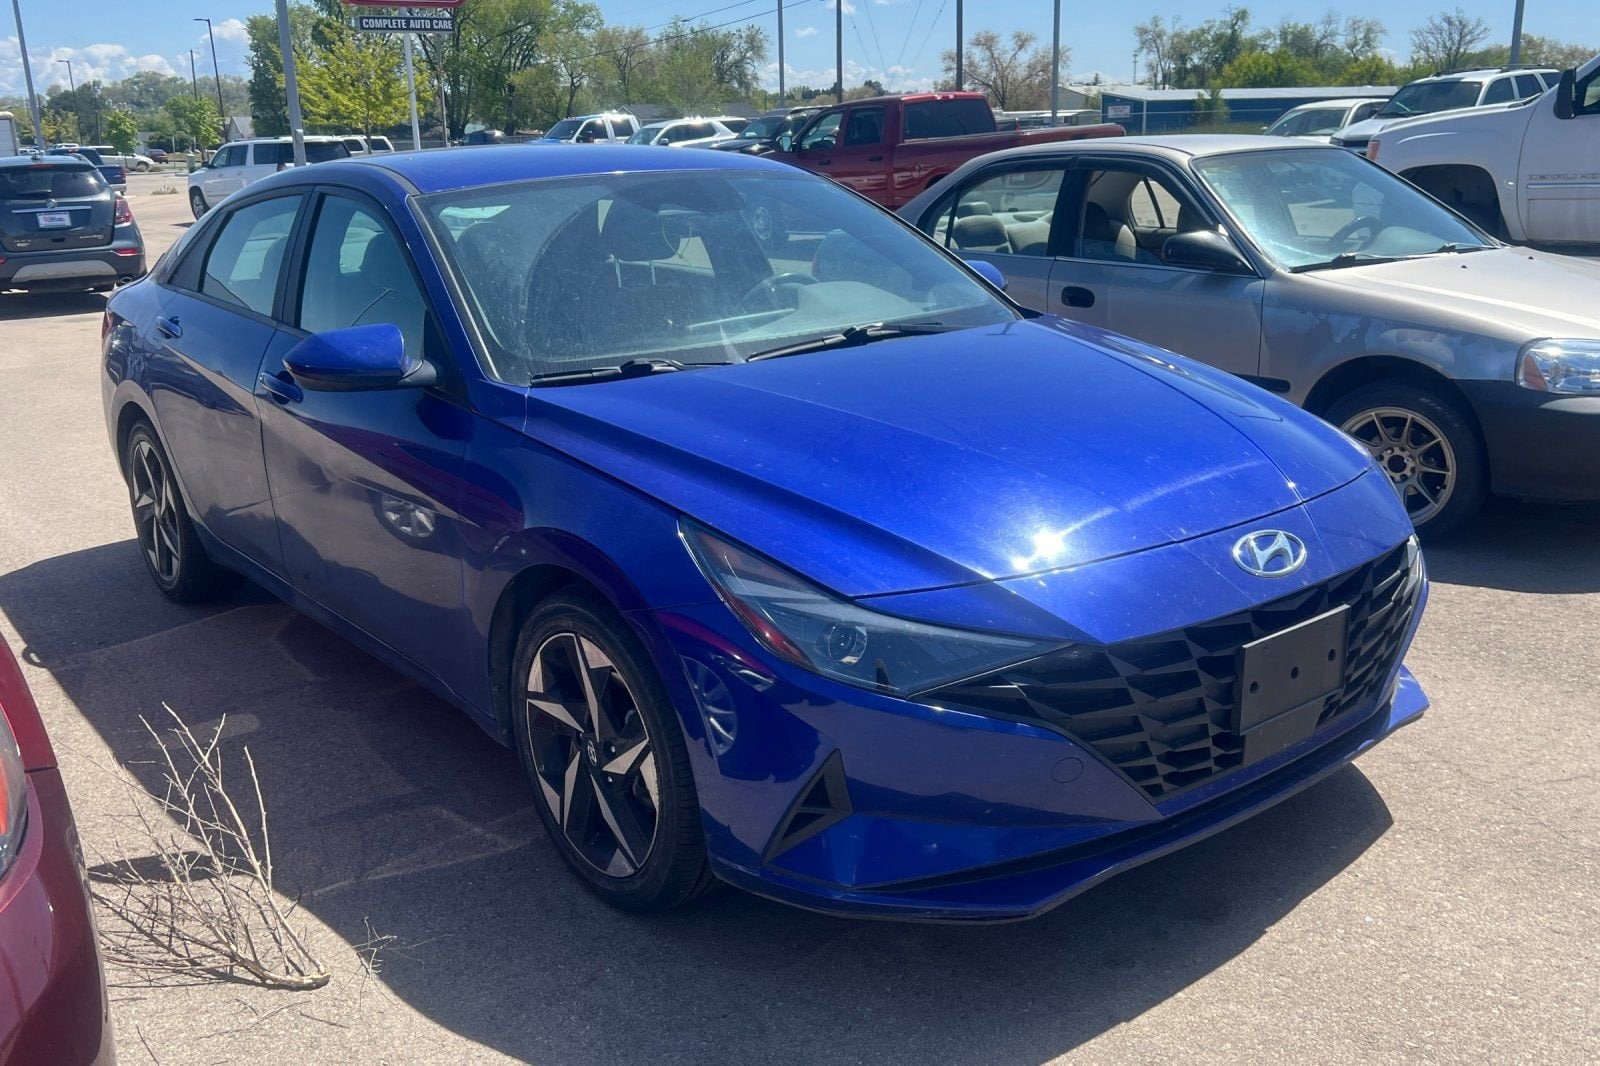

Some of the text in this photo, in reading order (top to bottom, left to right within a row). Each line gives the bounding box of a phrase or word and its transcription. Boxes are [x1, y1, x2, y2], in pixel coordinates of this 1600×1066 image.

[362, 18, 453, 30] COMPLETE AUTO CARE
